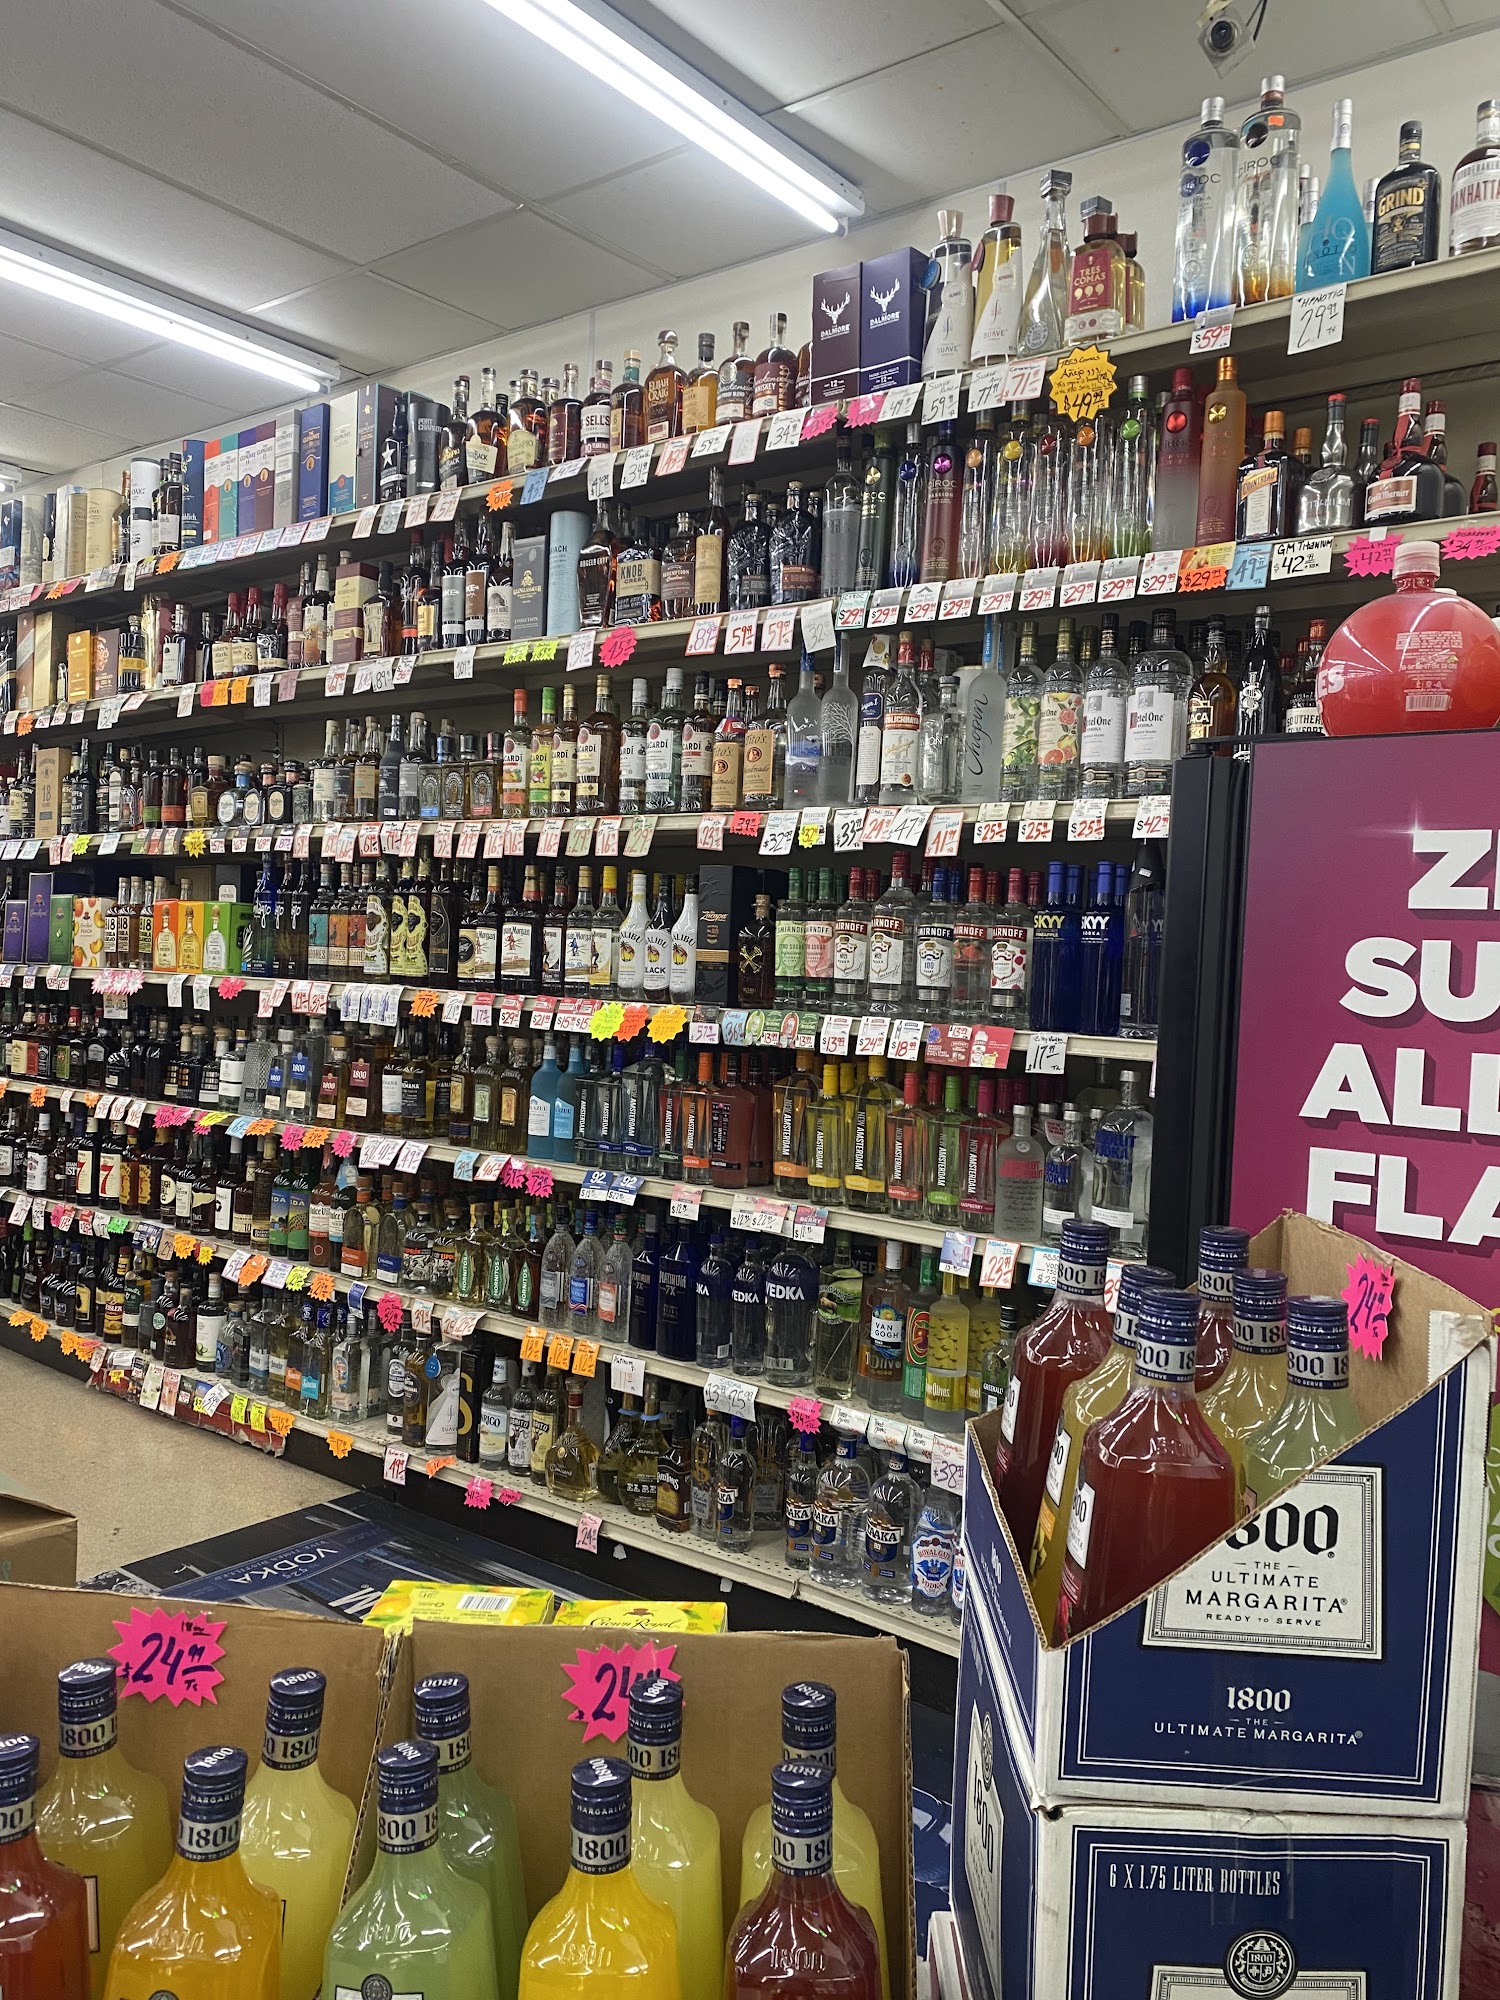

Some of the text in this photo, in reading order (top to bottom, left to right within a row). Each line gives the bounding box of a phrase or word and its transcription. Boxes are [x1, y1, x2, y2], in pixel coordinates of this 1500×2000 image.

[1378, 187, 1424, 216] GRIND
[1074, 272, 1106, 285] COMAS
[1080, 266, 1101, 278] TRES
[870, 311, 900, 327] DALMORE
[821, 325, 850, 340] DALMORE
[648, 387, 669, 398] CRAIG
[649, 379, 669, 392] ELIJAH
[418, 418, 434, 426] PORT
[1241, 470, 1277, 499] COINTREAU
[1278, 543, 1295, 556] GM
[620, 564, 643, 580] KNOB
[1097, 716, 1113, 726] One
[1149, 712, 1166, 722] One
[1408, 829, 1500, 910] Z
[1034, 915, 1066, 930] SKYY
[781, 1113, 793, 1156] AMSTERDAM
[815, 1129, 824, 1169] AMSTERDAM
[854, 1124, 865, 1171] AMSTERDAM
[893, 1138, 903, 1181] AMSTERDAM
[937, 1146, 948, 1187] AMSTERDAM
[100, 1165, 114, 1195] 7
[590, 1171, 607, 1183] 92
[622, 1175, 638, 1187] 92
[967, 1151, 978, 1195] AMSTERDAM
[874, 1329, 900, 1339] GOGH
[875, 1321, 893, 1332] VAN
[228, 1547, 338, 1586] VODKA
[1255, 1561, 1281, 1571] THE
[921, 1578, 943, 1590] VODKA
[1211, 1571, 1319, 1588] ULTIMATE
[1207, 1613, 1251, 1623] READY
[1276, 1617, 1322, 1626] SERVE
[282, 1669, 318, 1688] 1800
[421, 1677, 460, 1689] 1800
[643, 1678, 669, 1698] 1800
[794, 1683, 826, 1702] 1800
[1227, 1686, 1292, 1713] 1800
[1245, 1717, 1269, 1726] THE
[1154, 1722, 1247, 1739] ULTIMATE
[202, 1746, 235, 1769] 1800
[393, 1741, 423, 1761] 1800
[588, 1757, 617, 1785] 1800
[780, 1764, 823, 1779] 1800
[576, 1801, 628, 1816] MARGARITA
[577, 1835, 628, 1861] 1800
[1109, 1863, 1281, 1896] 6 X 1.75 LITER BOTTLES
[1250, 1953, 1273, 1964] 1800
